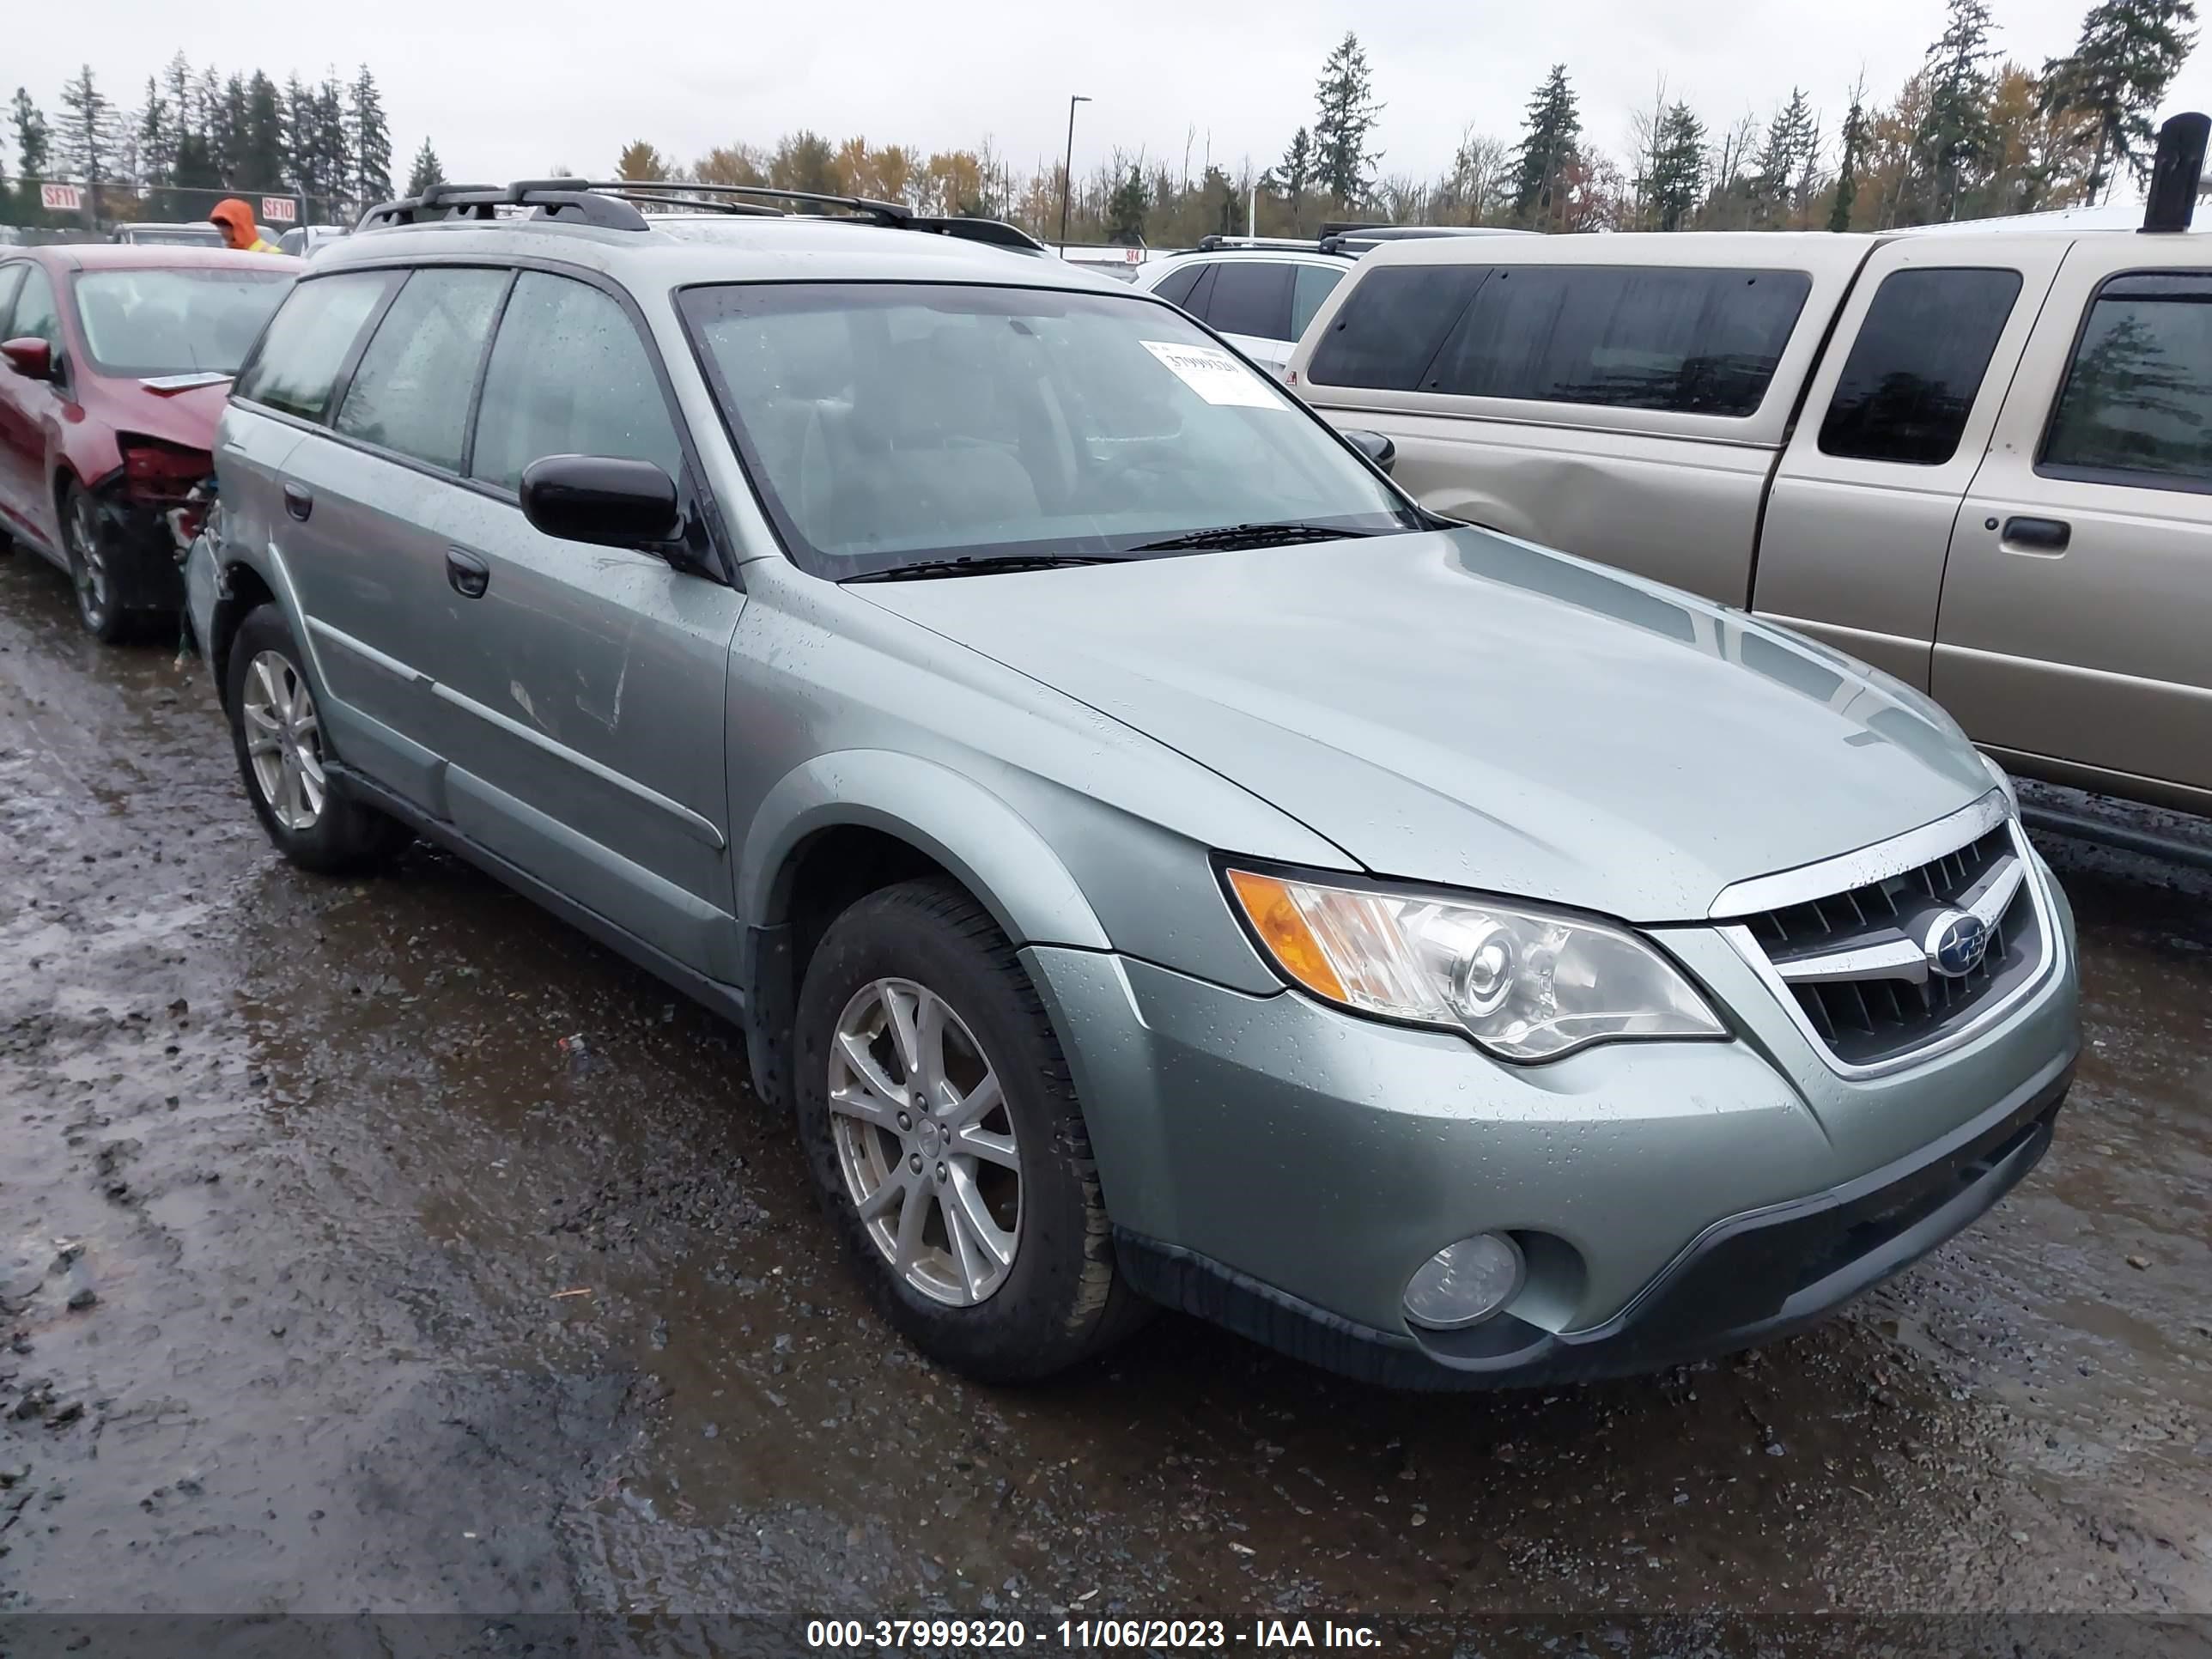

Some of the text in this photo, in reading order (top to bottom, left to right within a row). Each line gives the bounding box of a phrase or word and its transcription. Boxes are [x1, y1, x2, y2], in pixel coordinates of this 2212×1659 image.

[45, 186, 76, 206] SF11
[264, 198, 293, 218] SF10
[1127, 250, 1139, 262] SF4
[1166, 355, 1239, 374] 37999320
